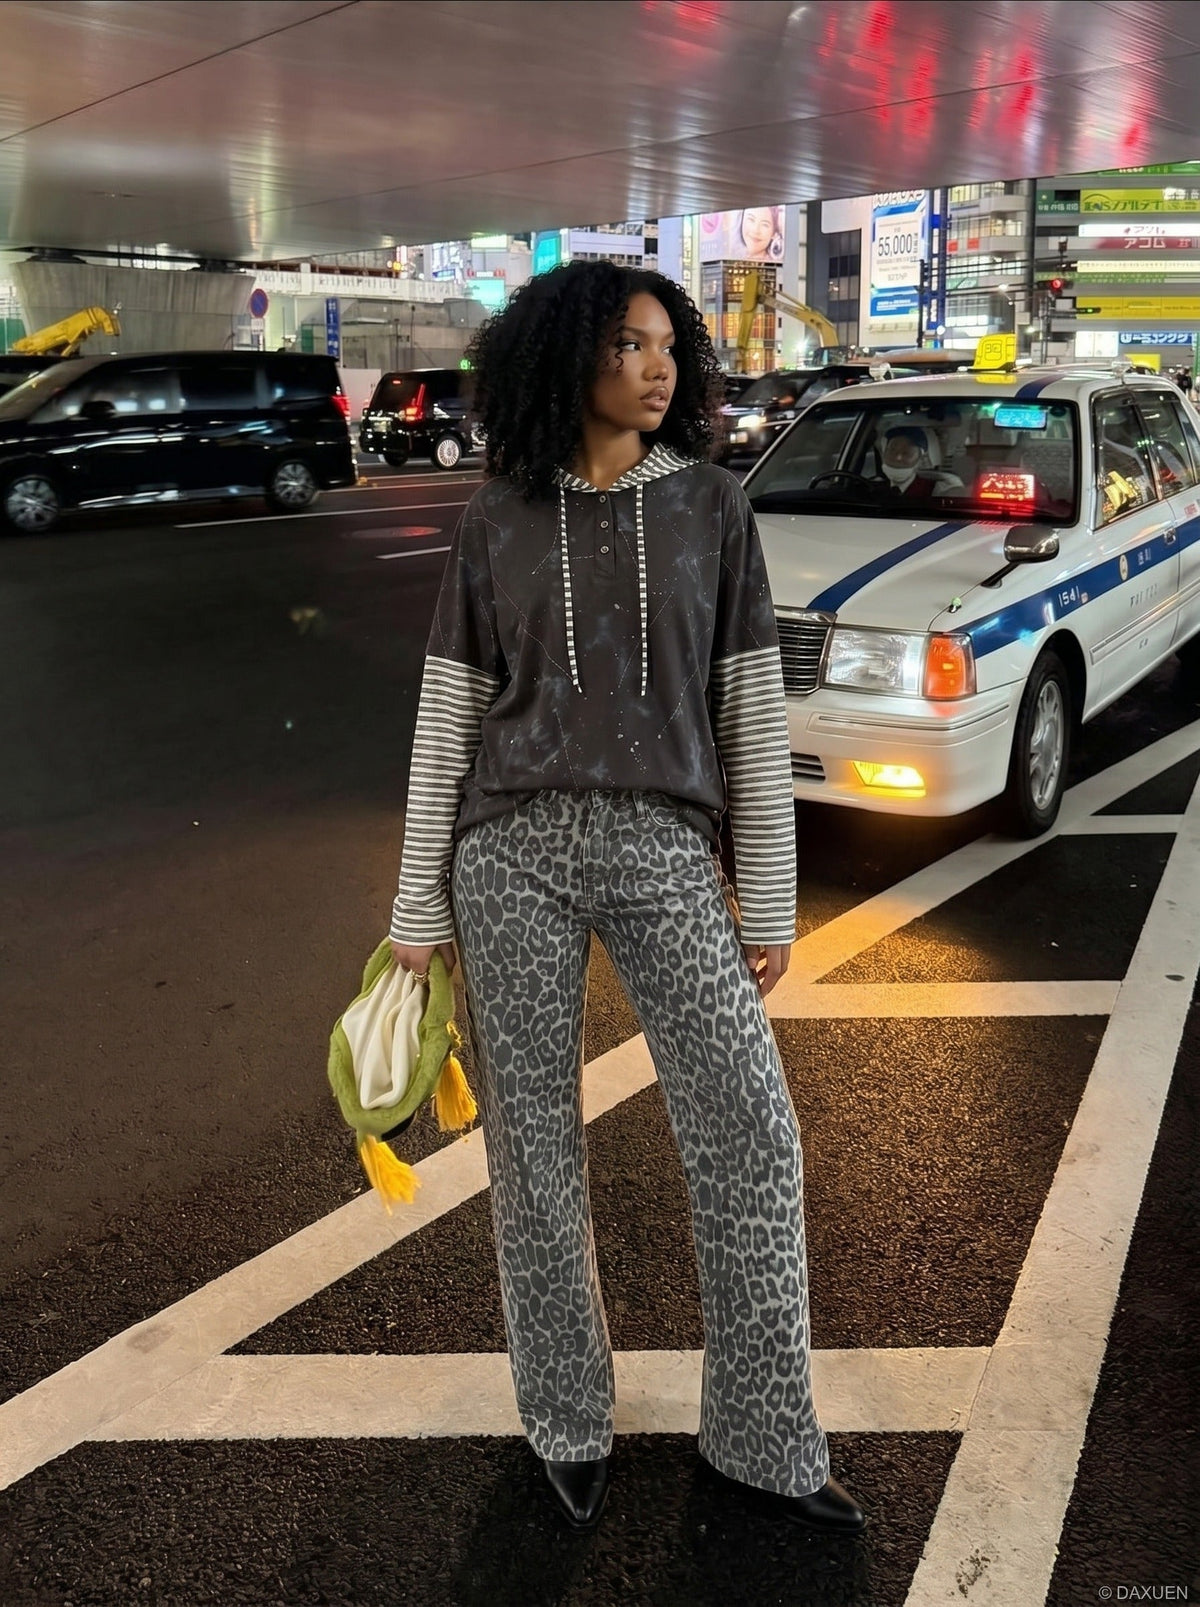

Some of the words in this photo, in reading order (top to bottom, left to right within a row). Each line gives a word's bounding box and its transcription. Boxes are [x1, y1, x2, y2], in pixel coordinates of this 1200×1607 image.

[878, 233, 913, 257] 55,000
[1123, 237, 1166, 249] アコム
